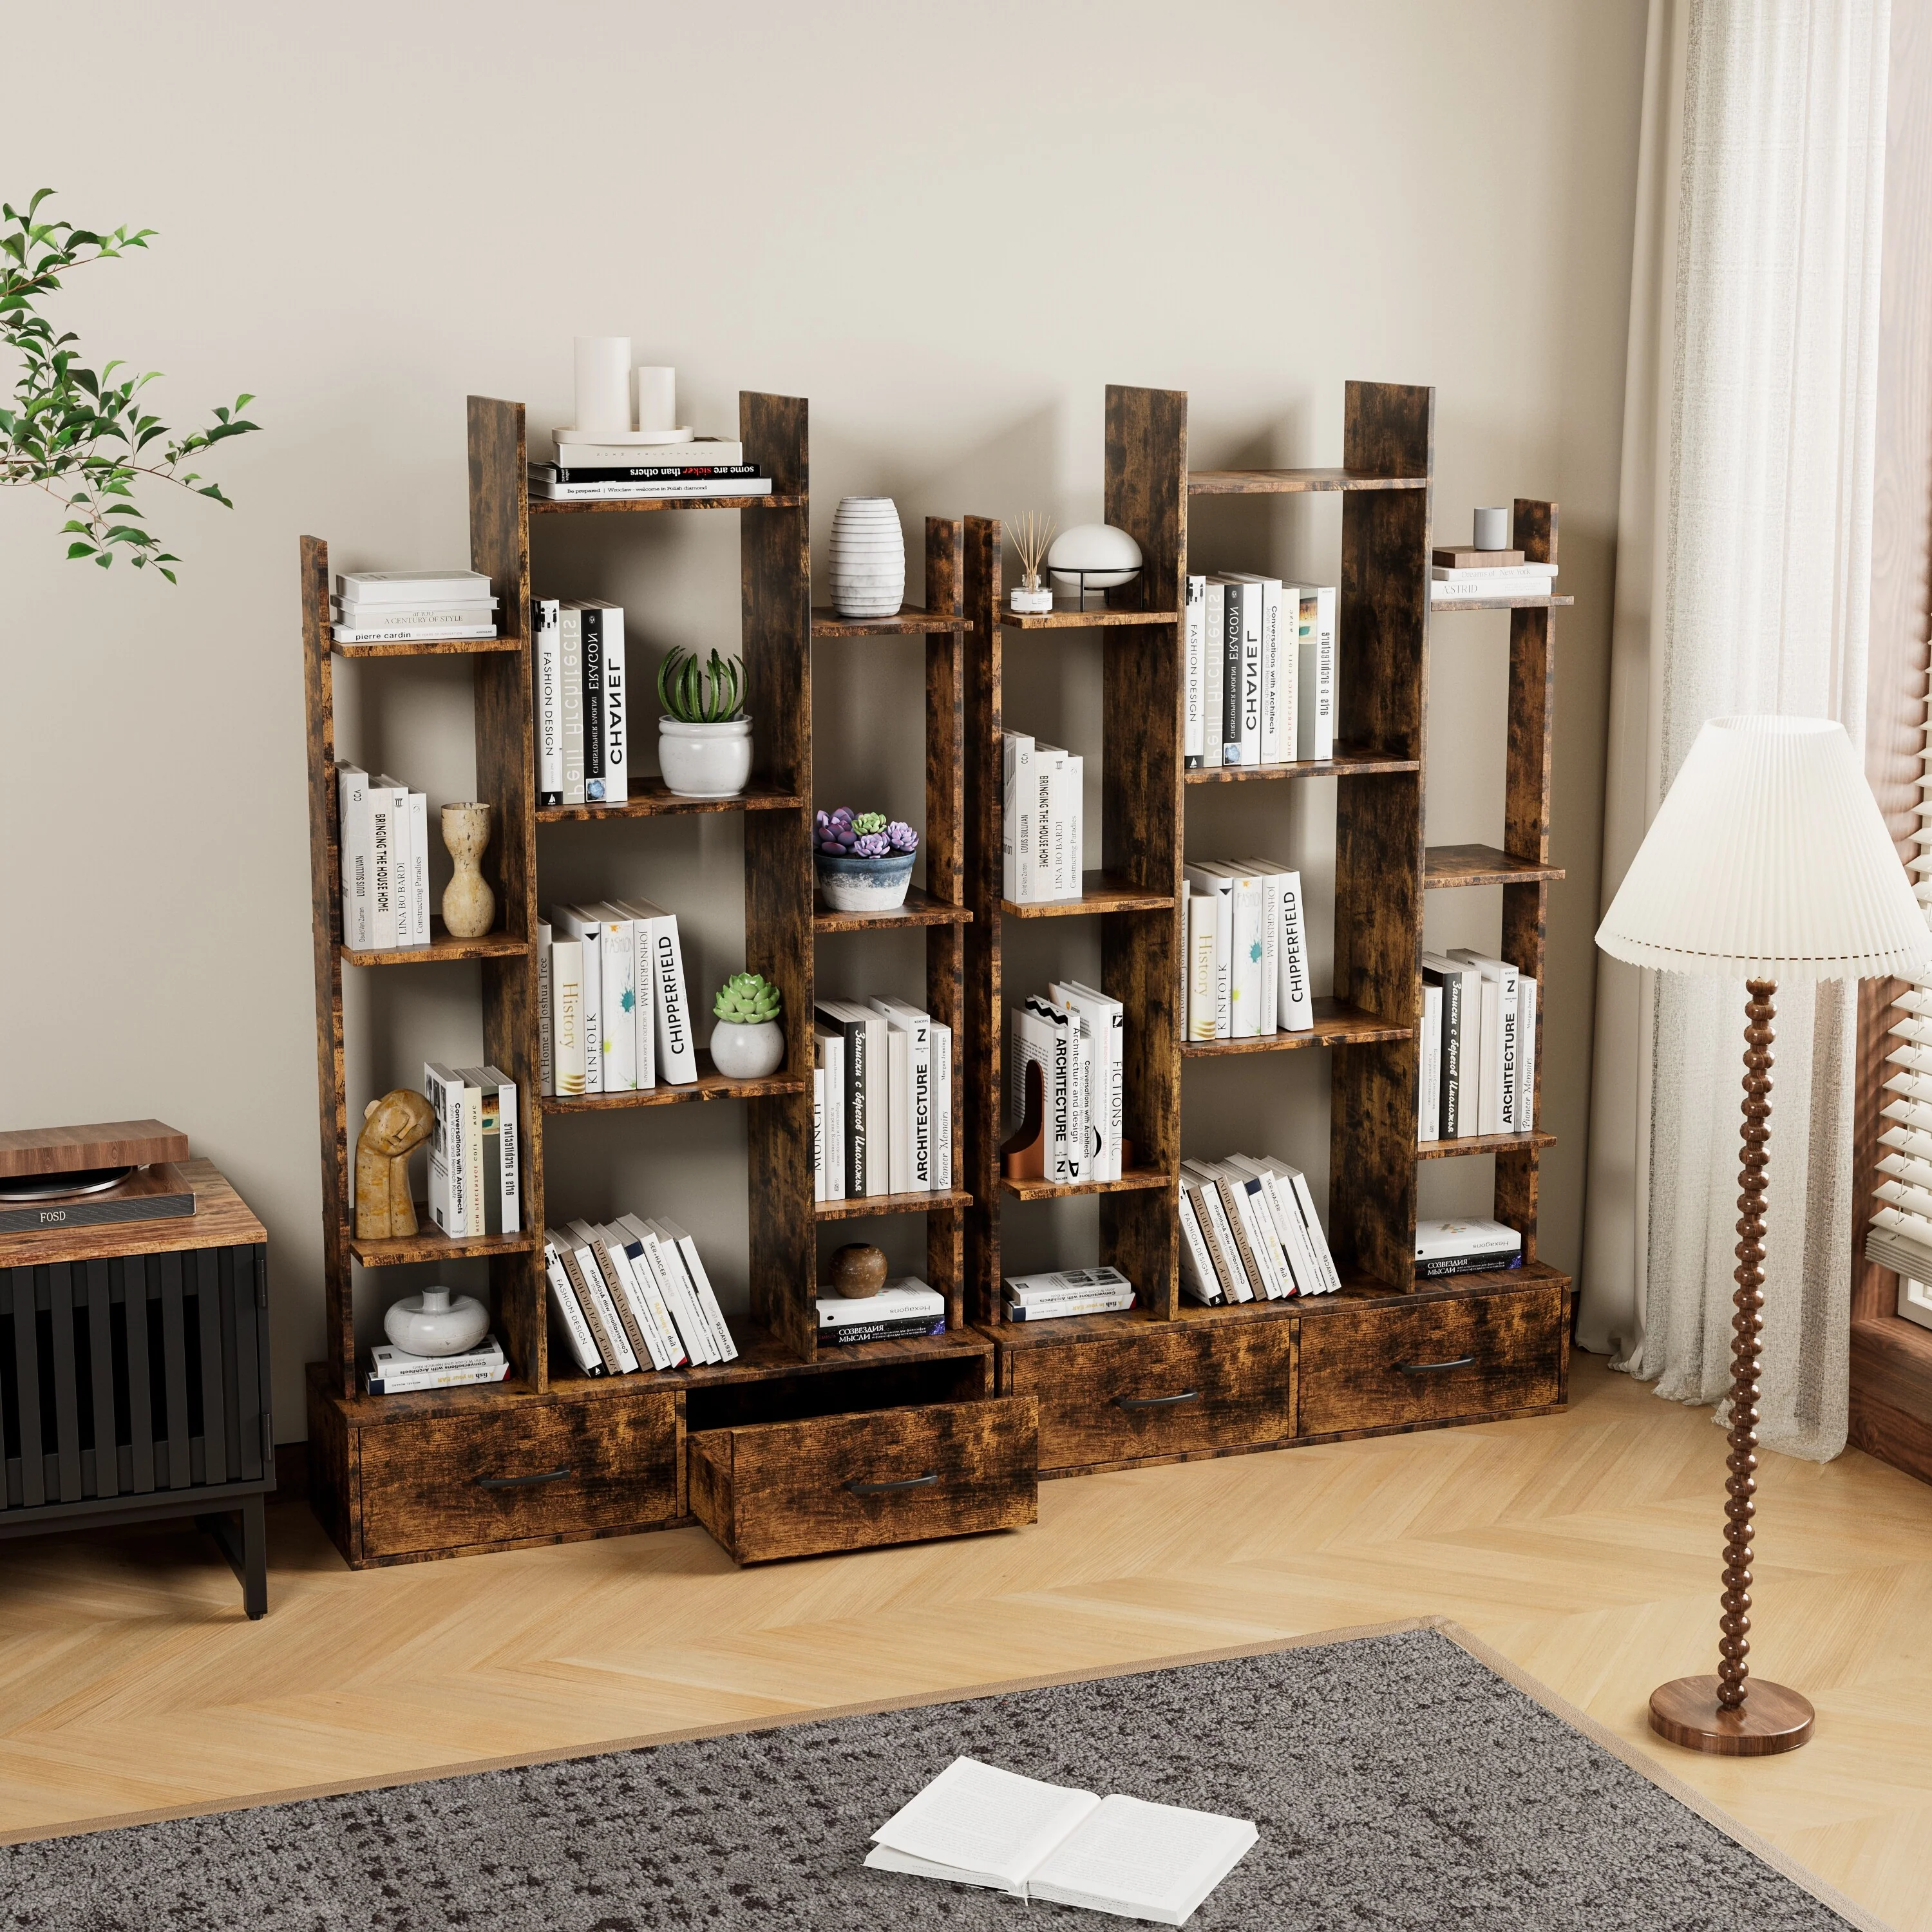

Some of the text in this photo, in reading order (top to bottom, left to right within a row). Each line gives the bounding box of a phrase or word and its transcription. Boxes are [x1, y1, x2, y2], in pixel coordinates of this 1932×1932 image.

[1462, 569, 1487, 578] Dreams
[544, 652, 554, 755] FASHION DESIGN
[1039, 776, 1048, 867] BRINGING THE HOUSE HOME
[355, 855, 364, 880] SULLIVAN
[375, 813, 388, 913] BRINGING THE HOUSE HOME
[1056, 853, 1063, 866] BO
[398, 895, 405, 909] BO
[1194, 935, 1212, 997] History
[1284, 891, 1303, 1002] CHIPPERFIELD
[540, 985, 551, 1021] Joshua
[658, 936, 685, 1054] CHIPPERFIELD
[1218, 964, 1227, 1030] KINFOLK
[1452, 980, 1462, 1025] Записки
[1507, 980, 1515, 992] N
[540, 1023, 549, 1035] in
[560, 983, 578, 1049] History
[918, 1028, 926, 1042] N
[540, 1038, 549, 1068] Home
[587, 1012, 597, 1084] KINFOLK
[855, 1030, 865, 1077] Записки
[1448, 1037, 1459, 1075] берегов
[1503, 1013, 1515, 1124] ARCHITECTURE
[541, 1073, 550, 1084] At
[1056, 1037, 1066, 1142] ARCHITECTURE
[1522, 1057, 1532, 1128] Pioneer Memoirs
[852, 1092, 864, 1131] берегов
[917, 1064, 927, 1182] ARCHITECTURE
[1111, 1061, 1122, 1160] FICTIONS INC.
[1448, 1079, 1459, 1133] Имоложья
[855, 1135, 865, 1192] Имоложья
[940, 1111, 949, 1186] Pioneer Memoirs
[1057, 1161, 1065, 1172] N
[40, 1211, 66, 1222] FOSD
[1218, 1177, 1260, 1286] PATRICK DEMARCHELIER
[1184, 1213, 1209, 1276] FASHION DESIGN
[1427, 1259, 1468, 1269] СОЗВЕЗДИЯ
[1427, 1267, 1455, 1276] МЫСЛИ
[556, 1279, 587, 1345] FASHION DESIGN
[594, 1240, 644, 1355] PATRICK DEMARCHELIER
[889, 1305, 930, 1314] Hexagons
[838, 1325, 884, 1336] СОЗВЕЗДИЯ
[839, 1334, 871, 1343] МЫСЛИ
